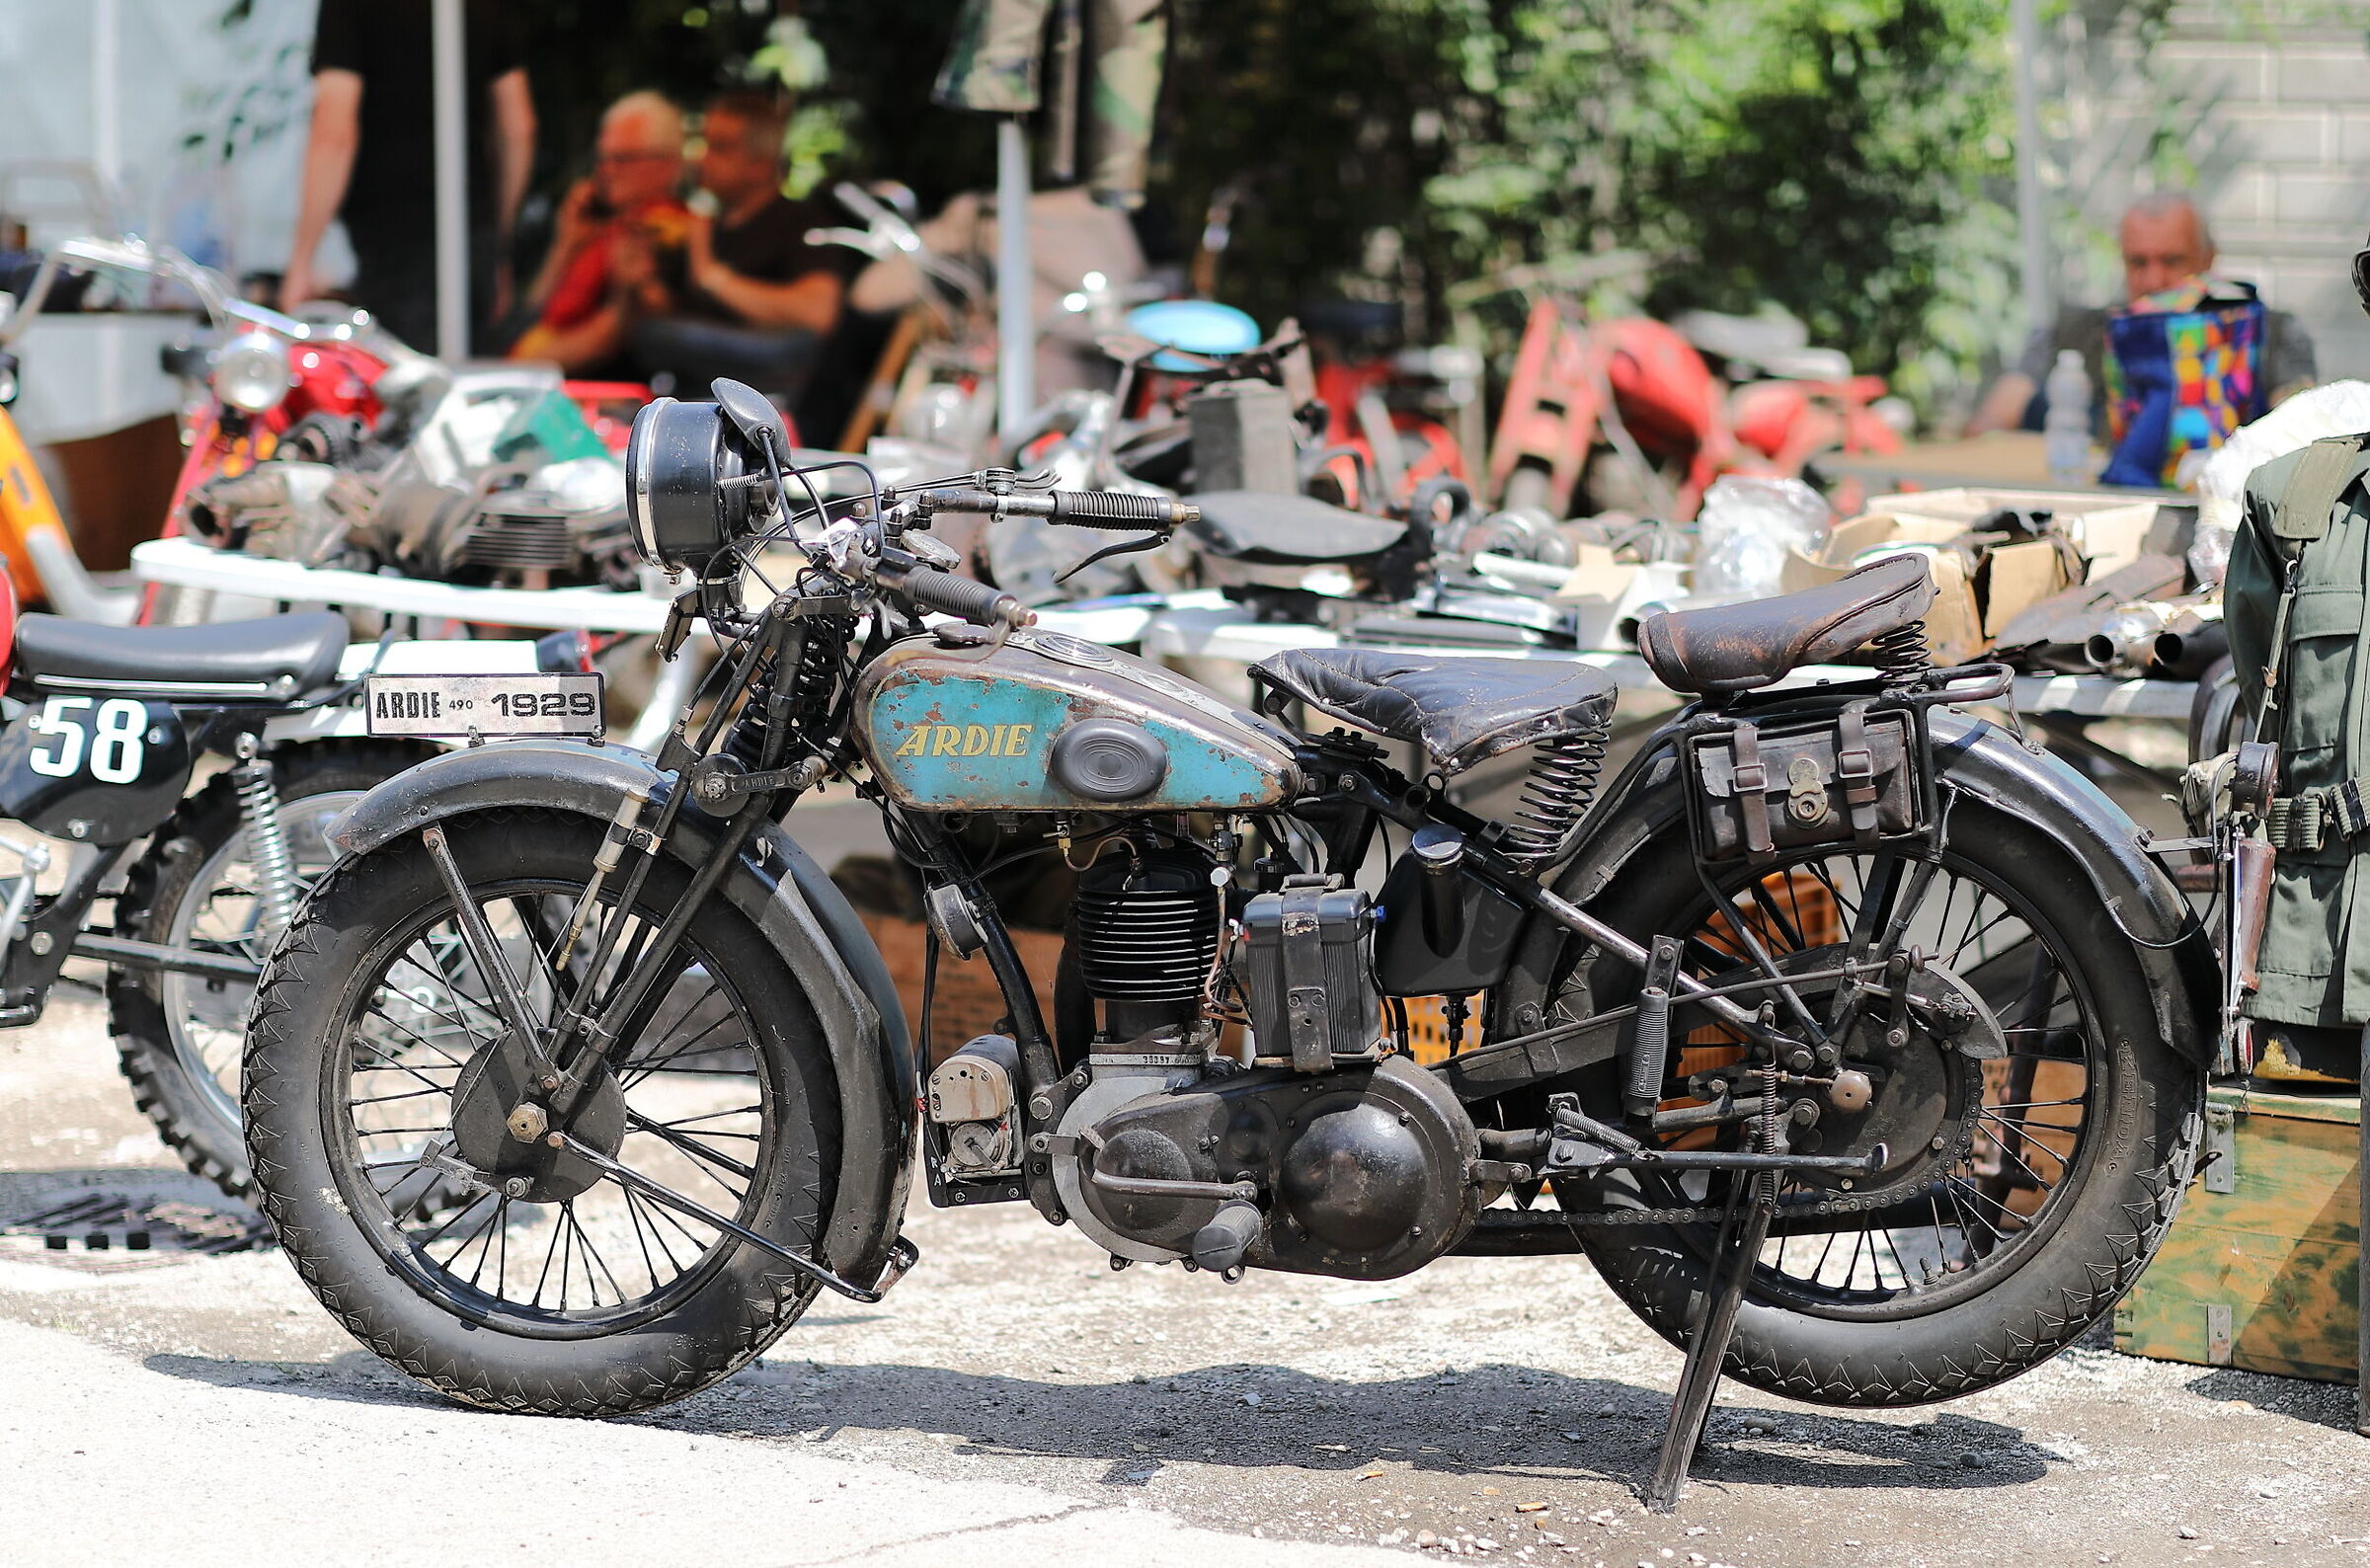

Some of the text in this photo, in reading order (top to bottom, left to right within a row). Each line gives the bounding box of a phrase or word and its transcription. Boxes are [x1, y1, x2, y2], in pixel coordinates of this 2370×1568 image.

[375, 691, 595, 719] ARDIE 490 1929
[29, 694, 148, 785] 58
[895, 723, 1033, 757] ARDIE
